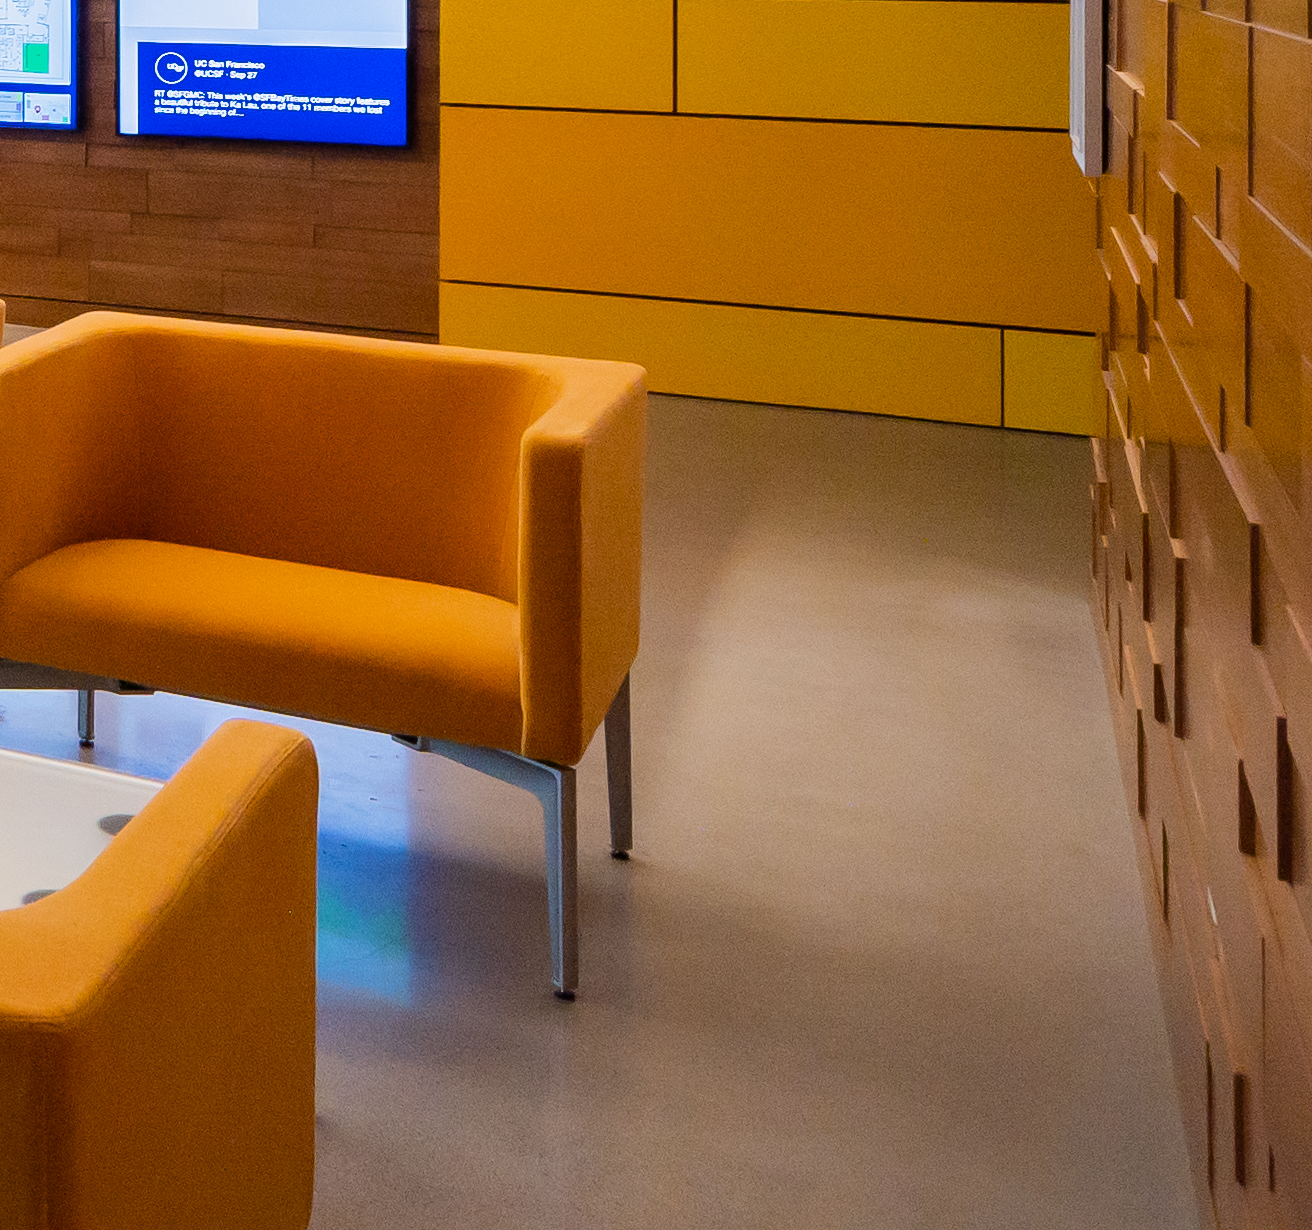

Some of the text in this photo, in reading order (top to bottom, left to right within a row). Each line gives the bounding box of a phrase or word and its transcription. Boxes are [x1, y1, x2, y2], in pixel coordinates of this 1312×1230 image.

[194, 60, 207, 68] UC
[208, 60, 225, 68] San
[230, 71, 246, 80] Sep
